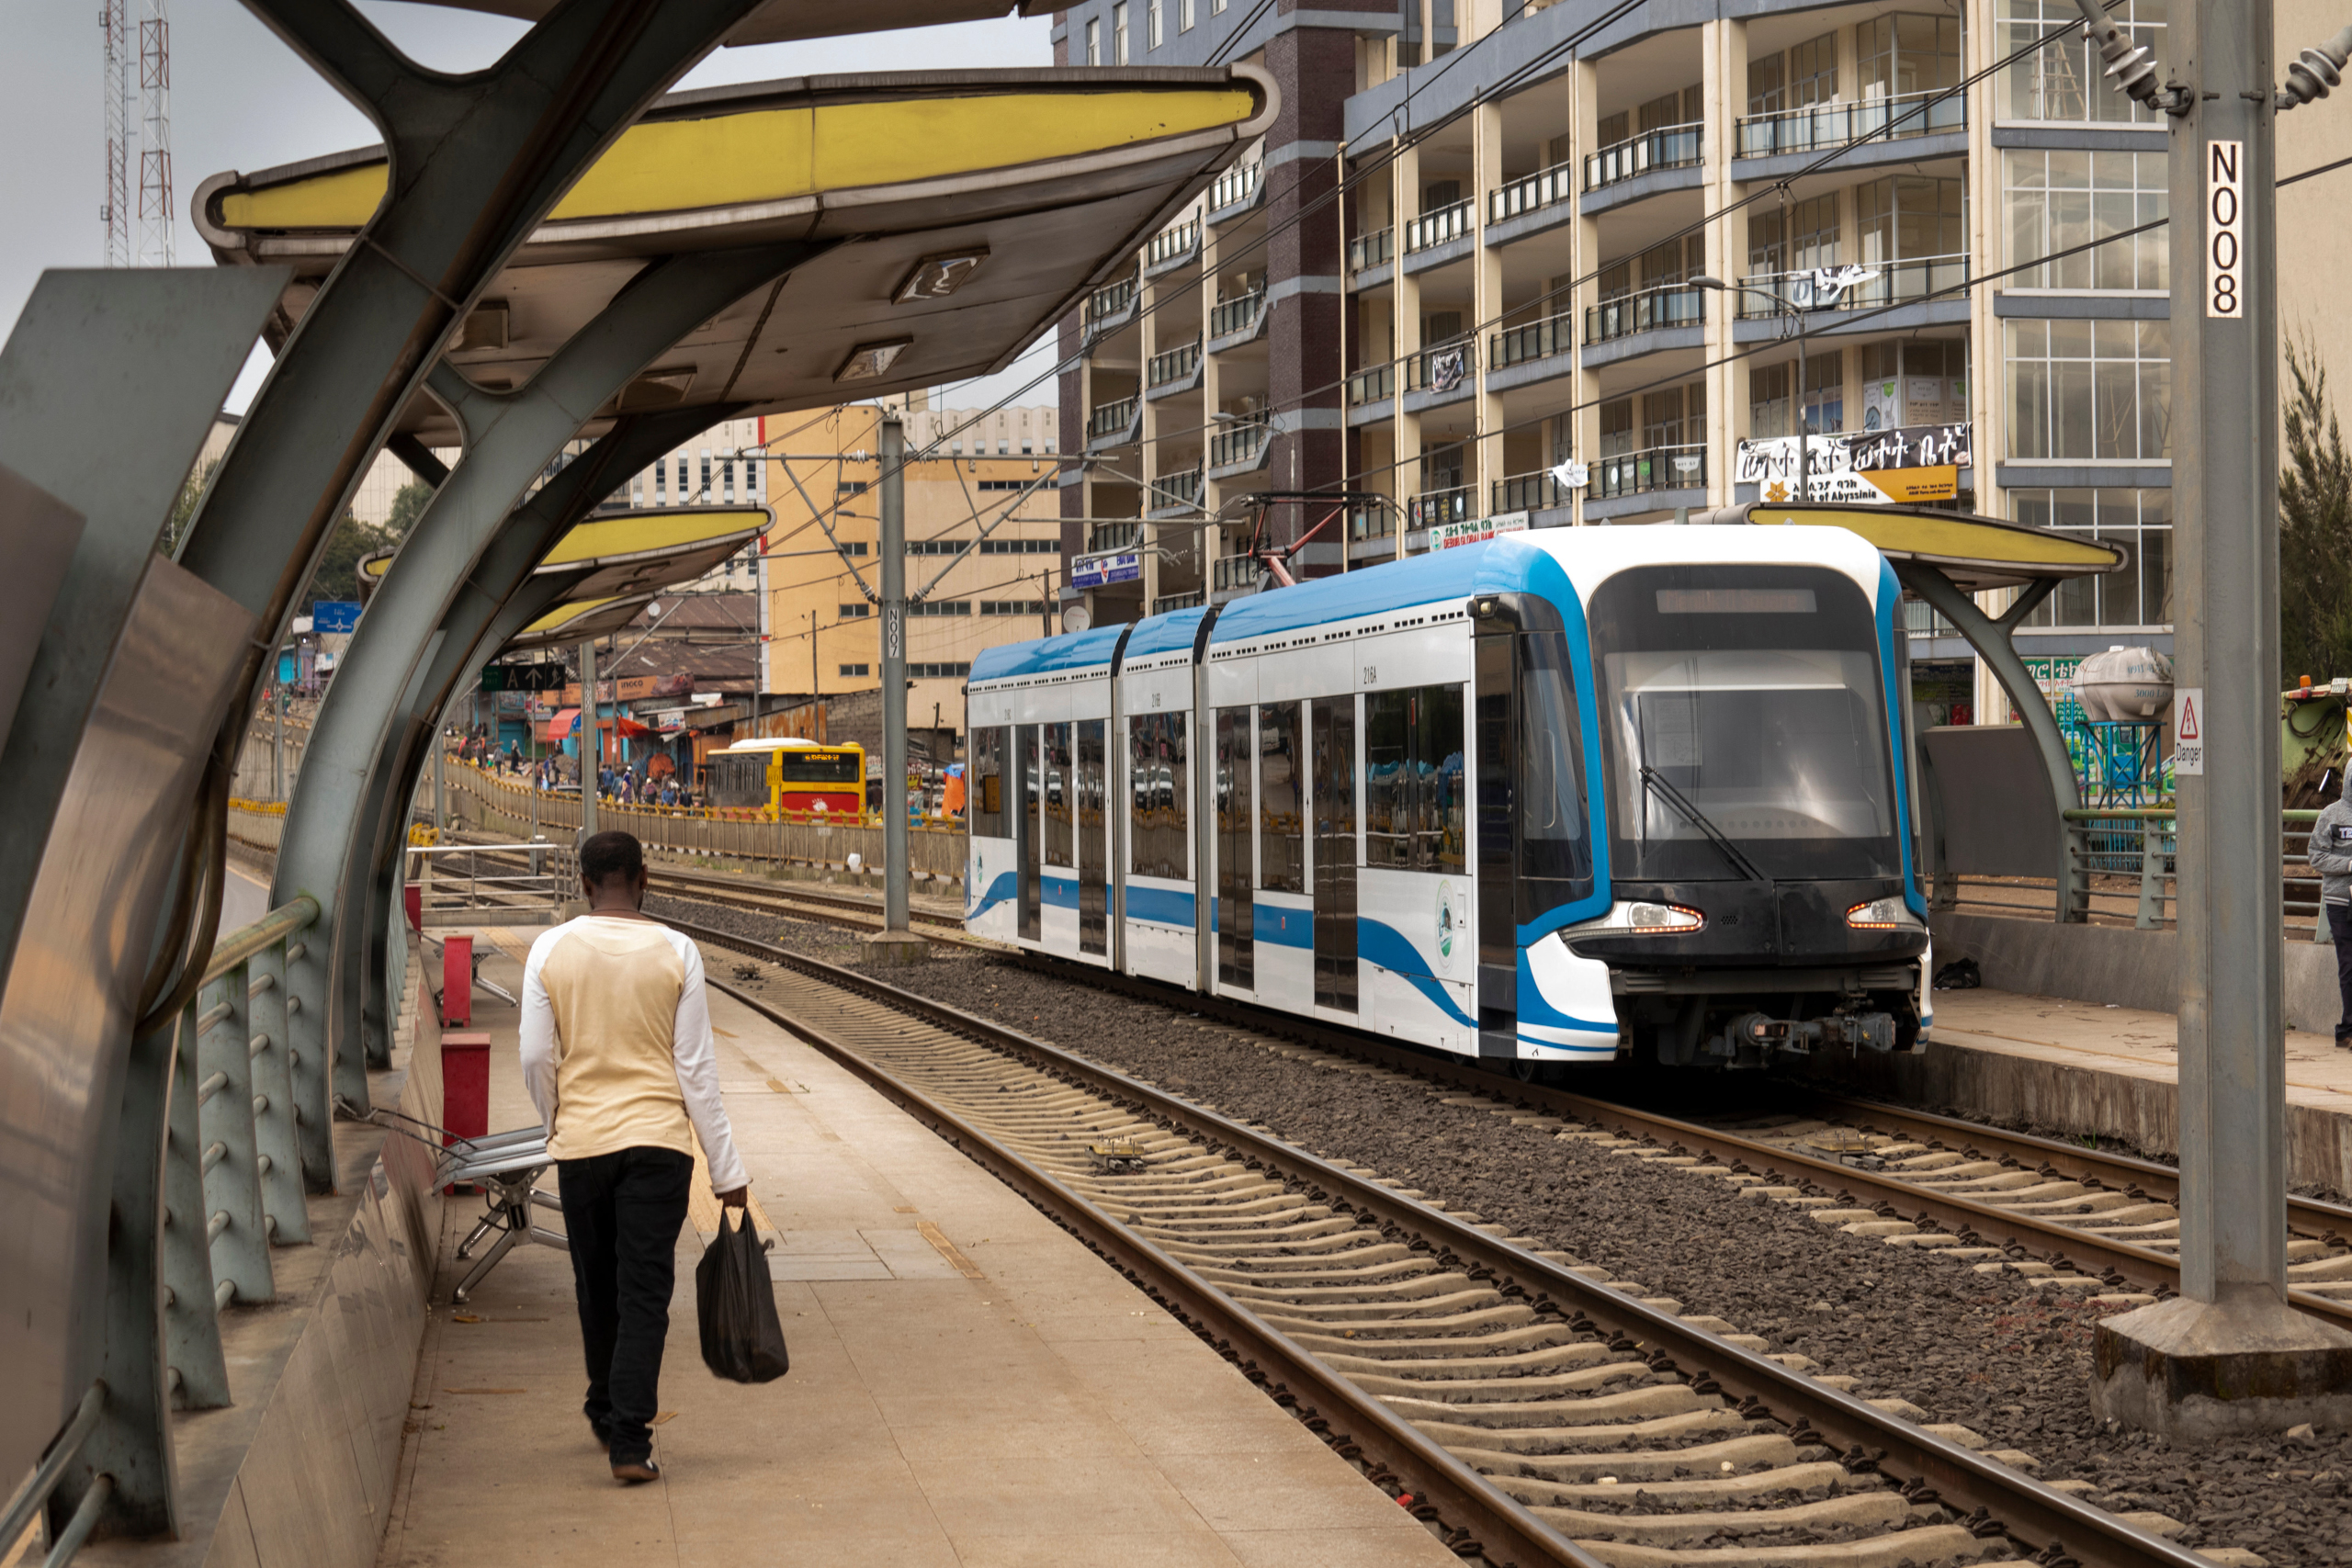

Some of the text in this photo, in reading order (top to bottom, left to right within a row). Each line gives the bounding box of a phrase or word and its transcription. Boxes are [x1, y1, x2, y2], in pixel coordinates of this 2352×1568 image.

[2212, 144, 2237, 313] N008
[1818, 491, 1829, 502] of
[1831, 489, 1877, 502] Abyssinia
[1480, 530, 1496, 542] BANK
[889, 609, 899, 657] N007
[507, 668, 519, 688] A
[1363, 665, 1377, 684] 216A
[2134, 689, 2155, 698] 3000
[2177, 743, 2201, 766] Danger
